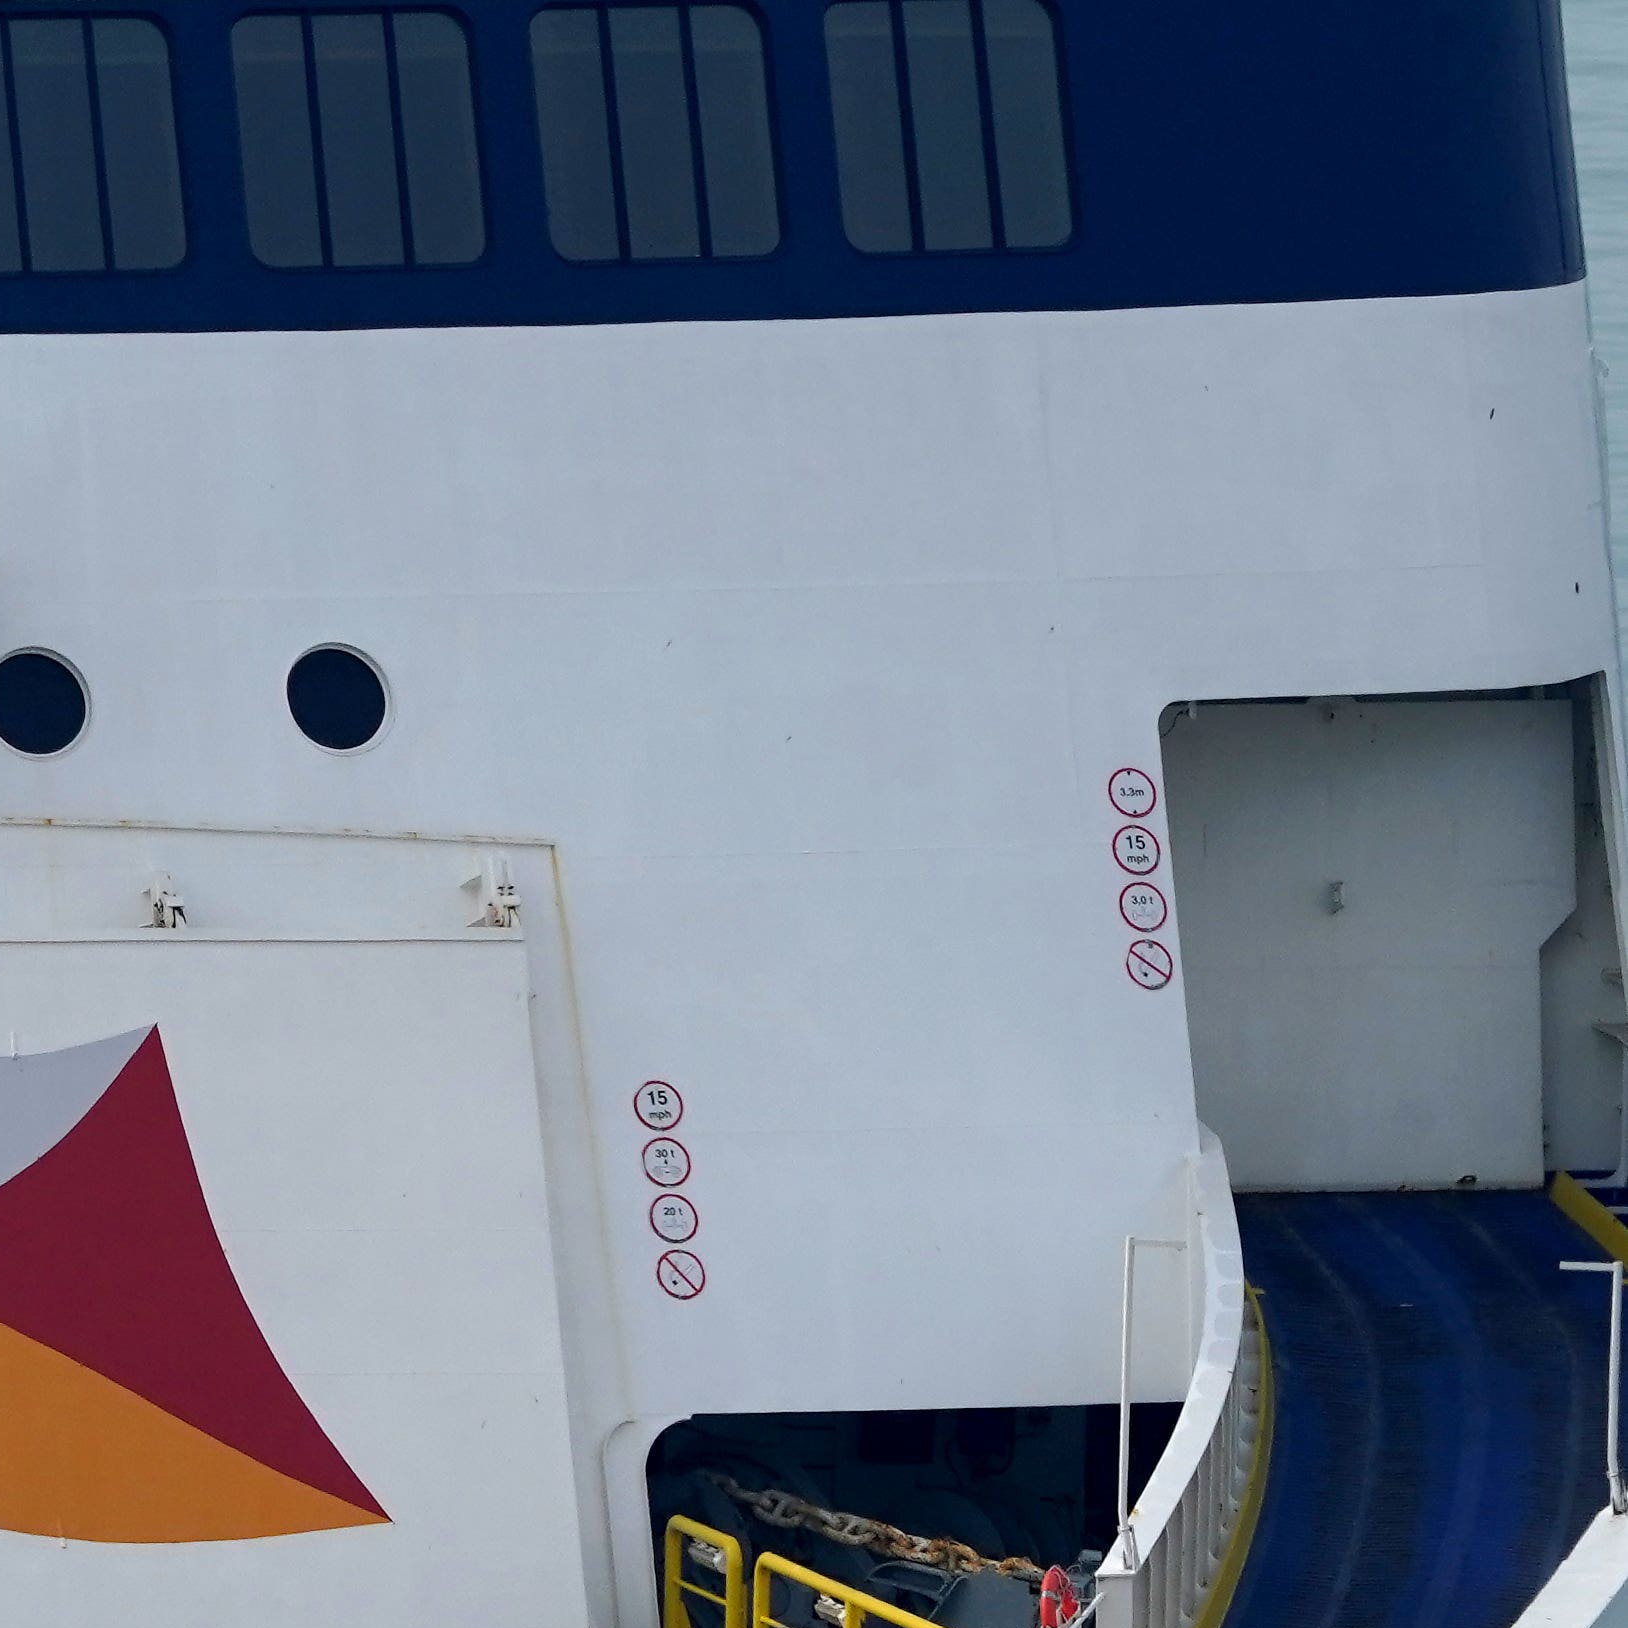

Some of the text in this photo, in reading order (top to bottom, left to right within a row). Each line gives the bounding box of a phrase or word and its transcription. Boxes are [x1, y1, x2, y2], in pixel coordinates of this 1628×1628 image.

[1125, 835, 1146, 850] 15
[1127, 854, 1150, 865] mph
[647, 1091, 668, 1106] 15
[649, 1110, 672, 1121] mph
